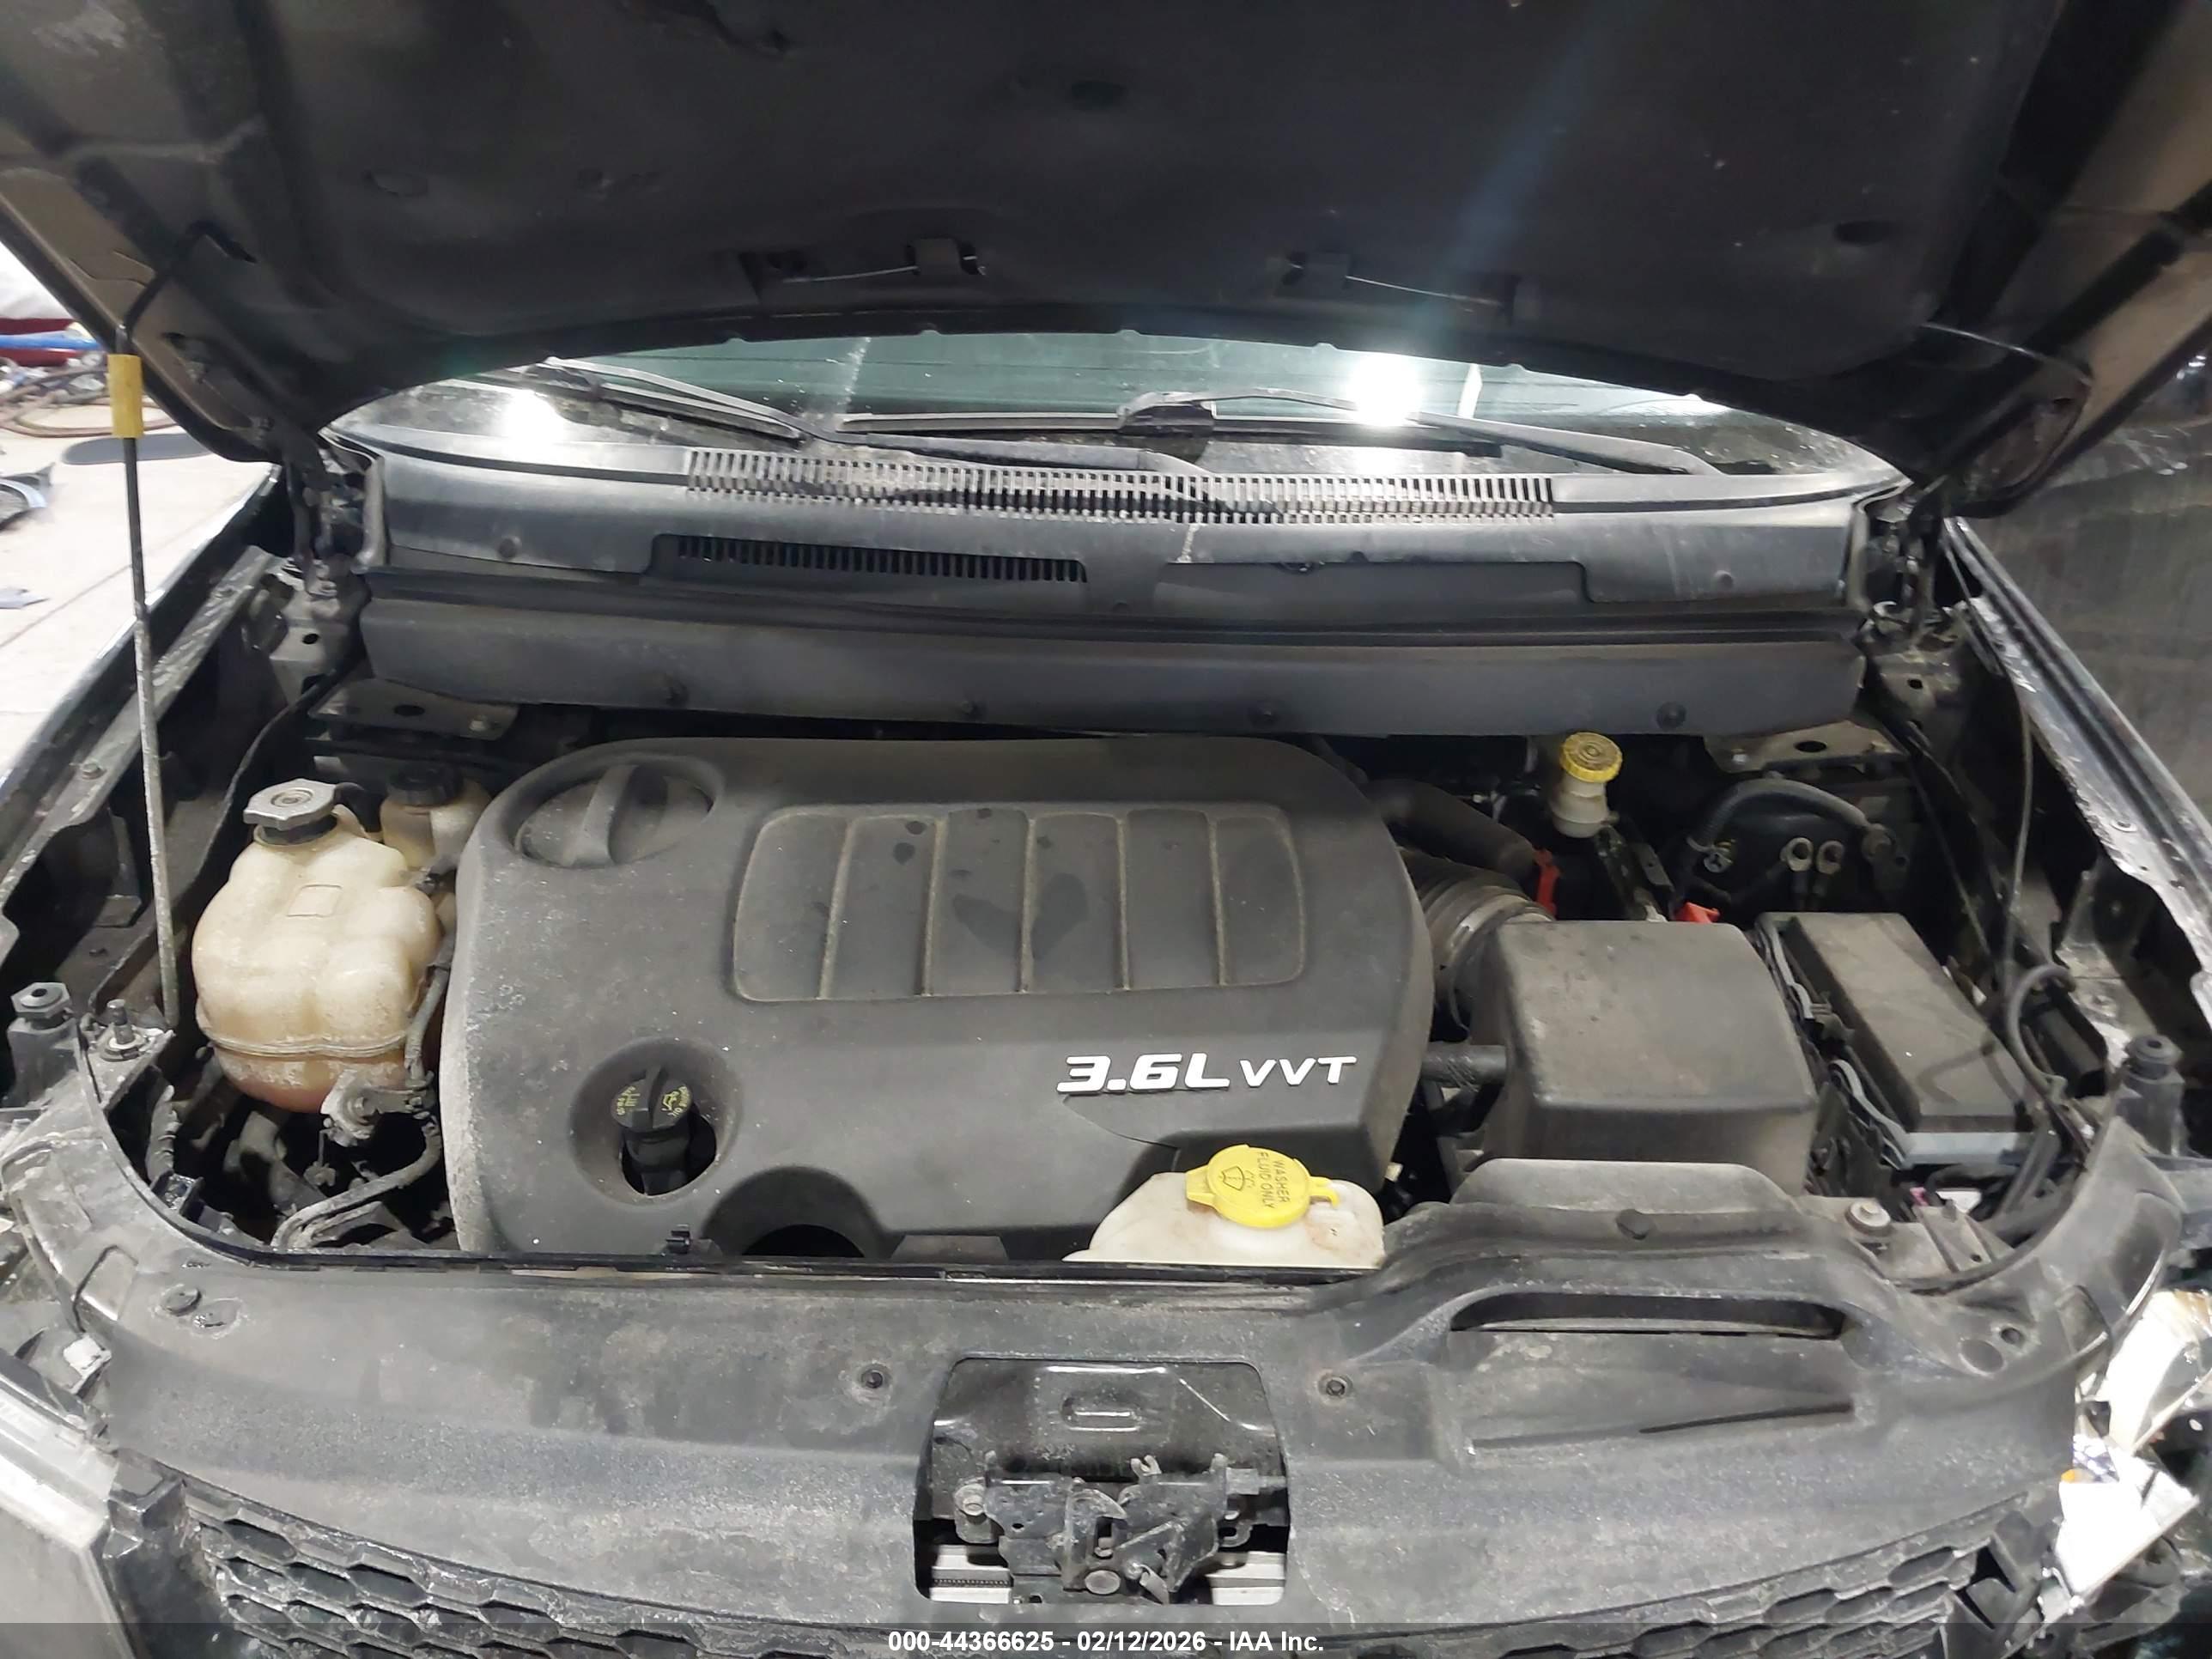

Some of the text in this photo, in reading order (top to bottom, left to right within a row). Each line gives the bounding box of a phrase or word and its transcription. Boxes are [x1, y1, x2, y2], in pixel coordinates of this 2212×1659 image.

[1056, 1052, 1358, 1093] 3.6L VVT
[1257, 1152, 1275, 1208] FLUID ONLY
[1273, 1160, 1290, 1202] WASHER
